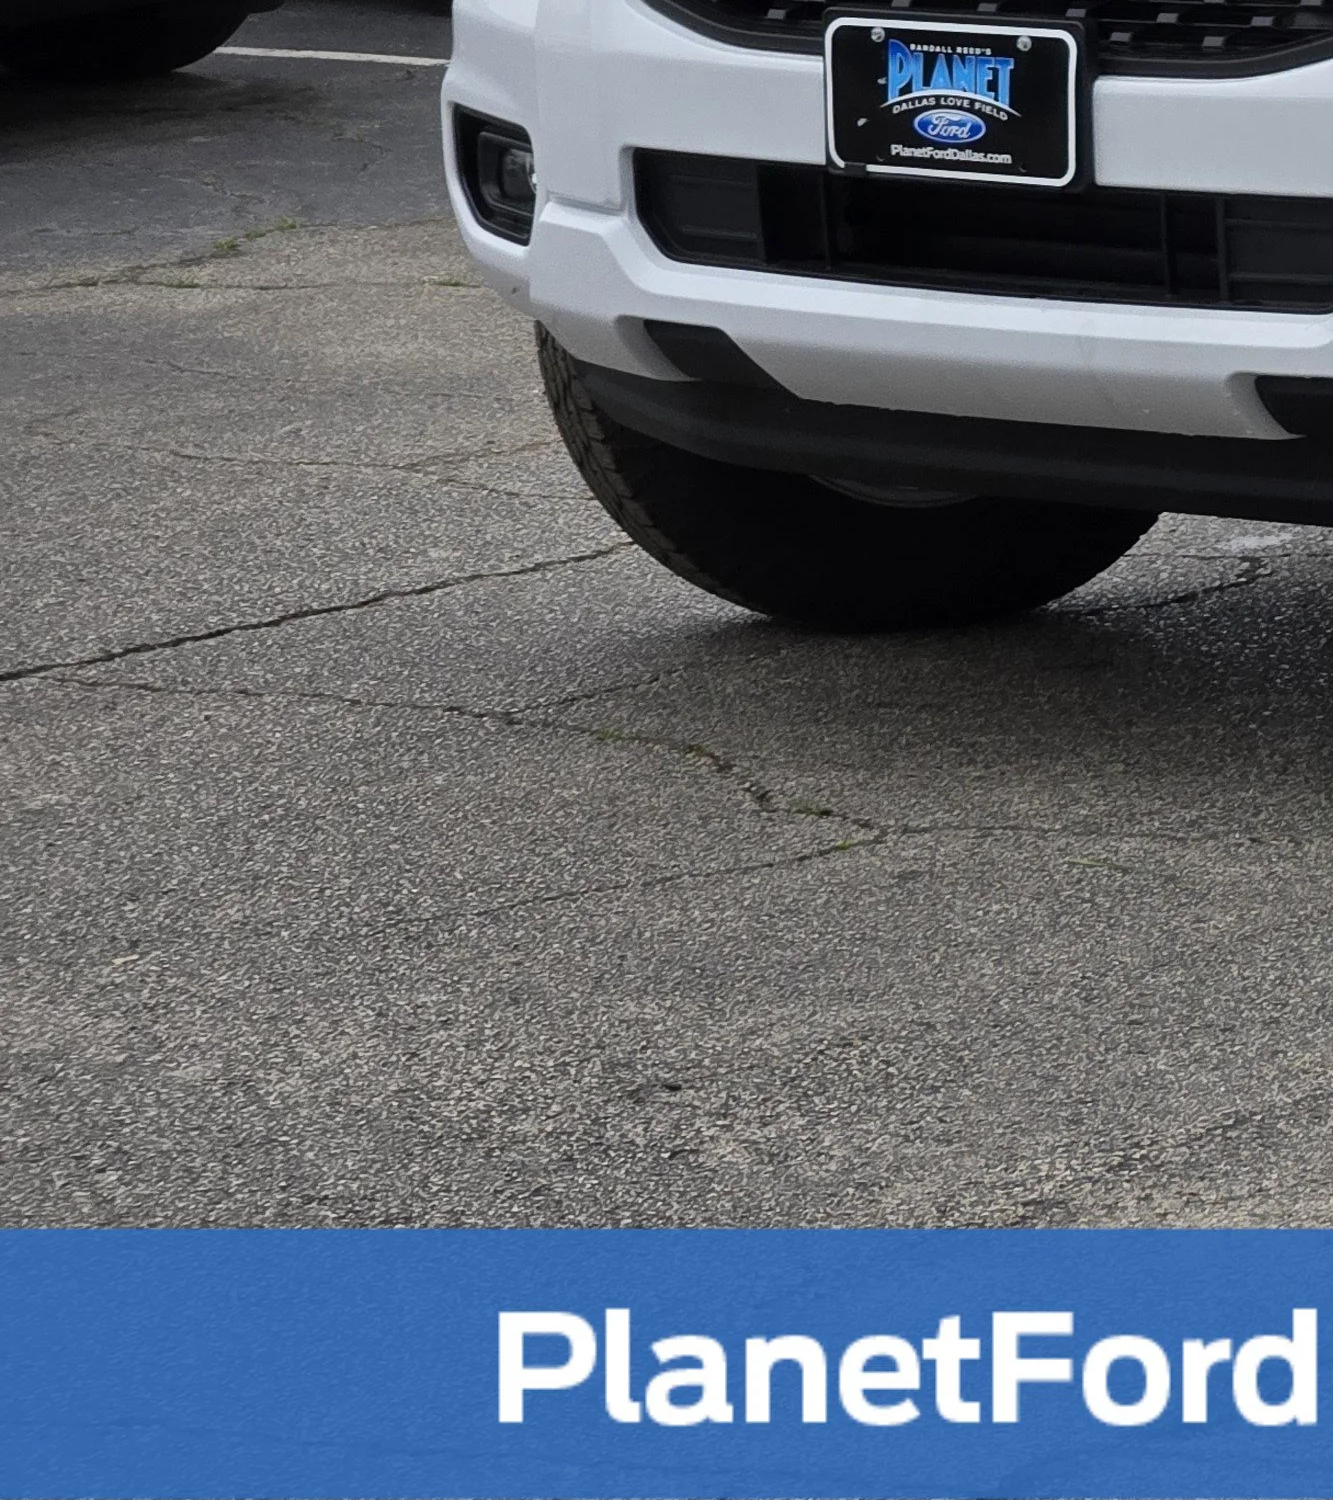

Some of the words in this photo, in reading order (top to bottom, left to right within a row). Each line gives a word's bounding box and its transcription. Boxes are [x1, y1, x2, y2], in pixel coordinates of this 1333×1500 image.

[888, 38, 1015, 108] PLANET
[892, 97, 937, 114] DALLAS
[940, 97, 971, 108] LOVE
[974, 101, 1008, 121] FIELD
[927, 114, 972, 139] Ford
